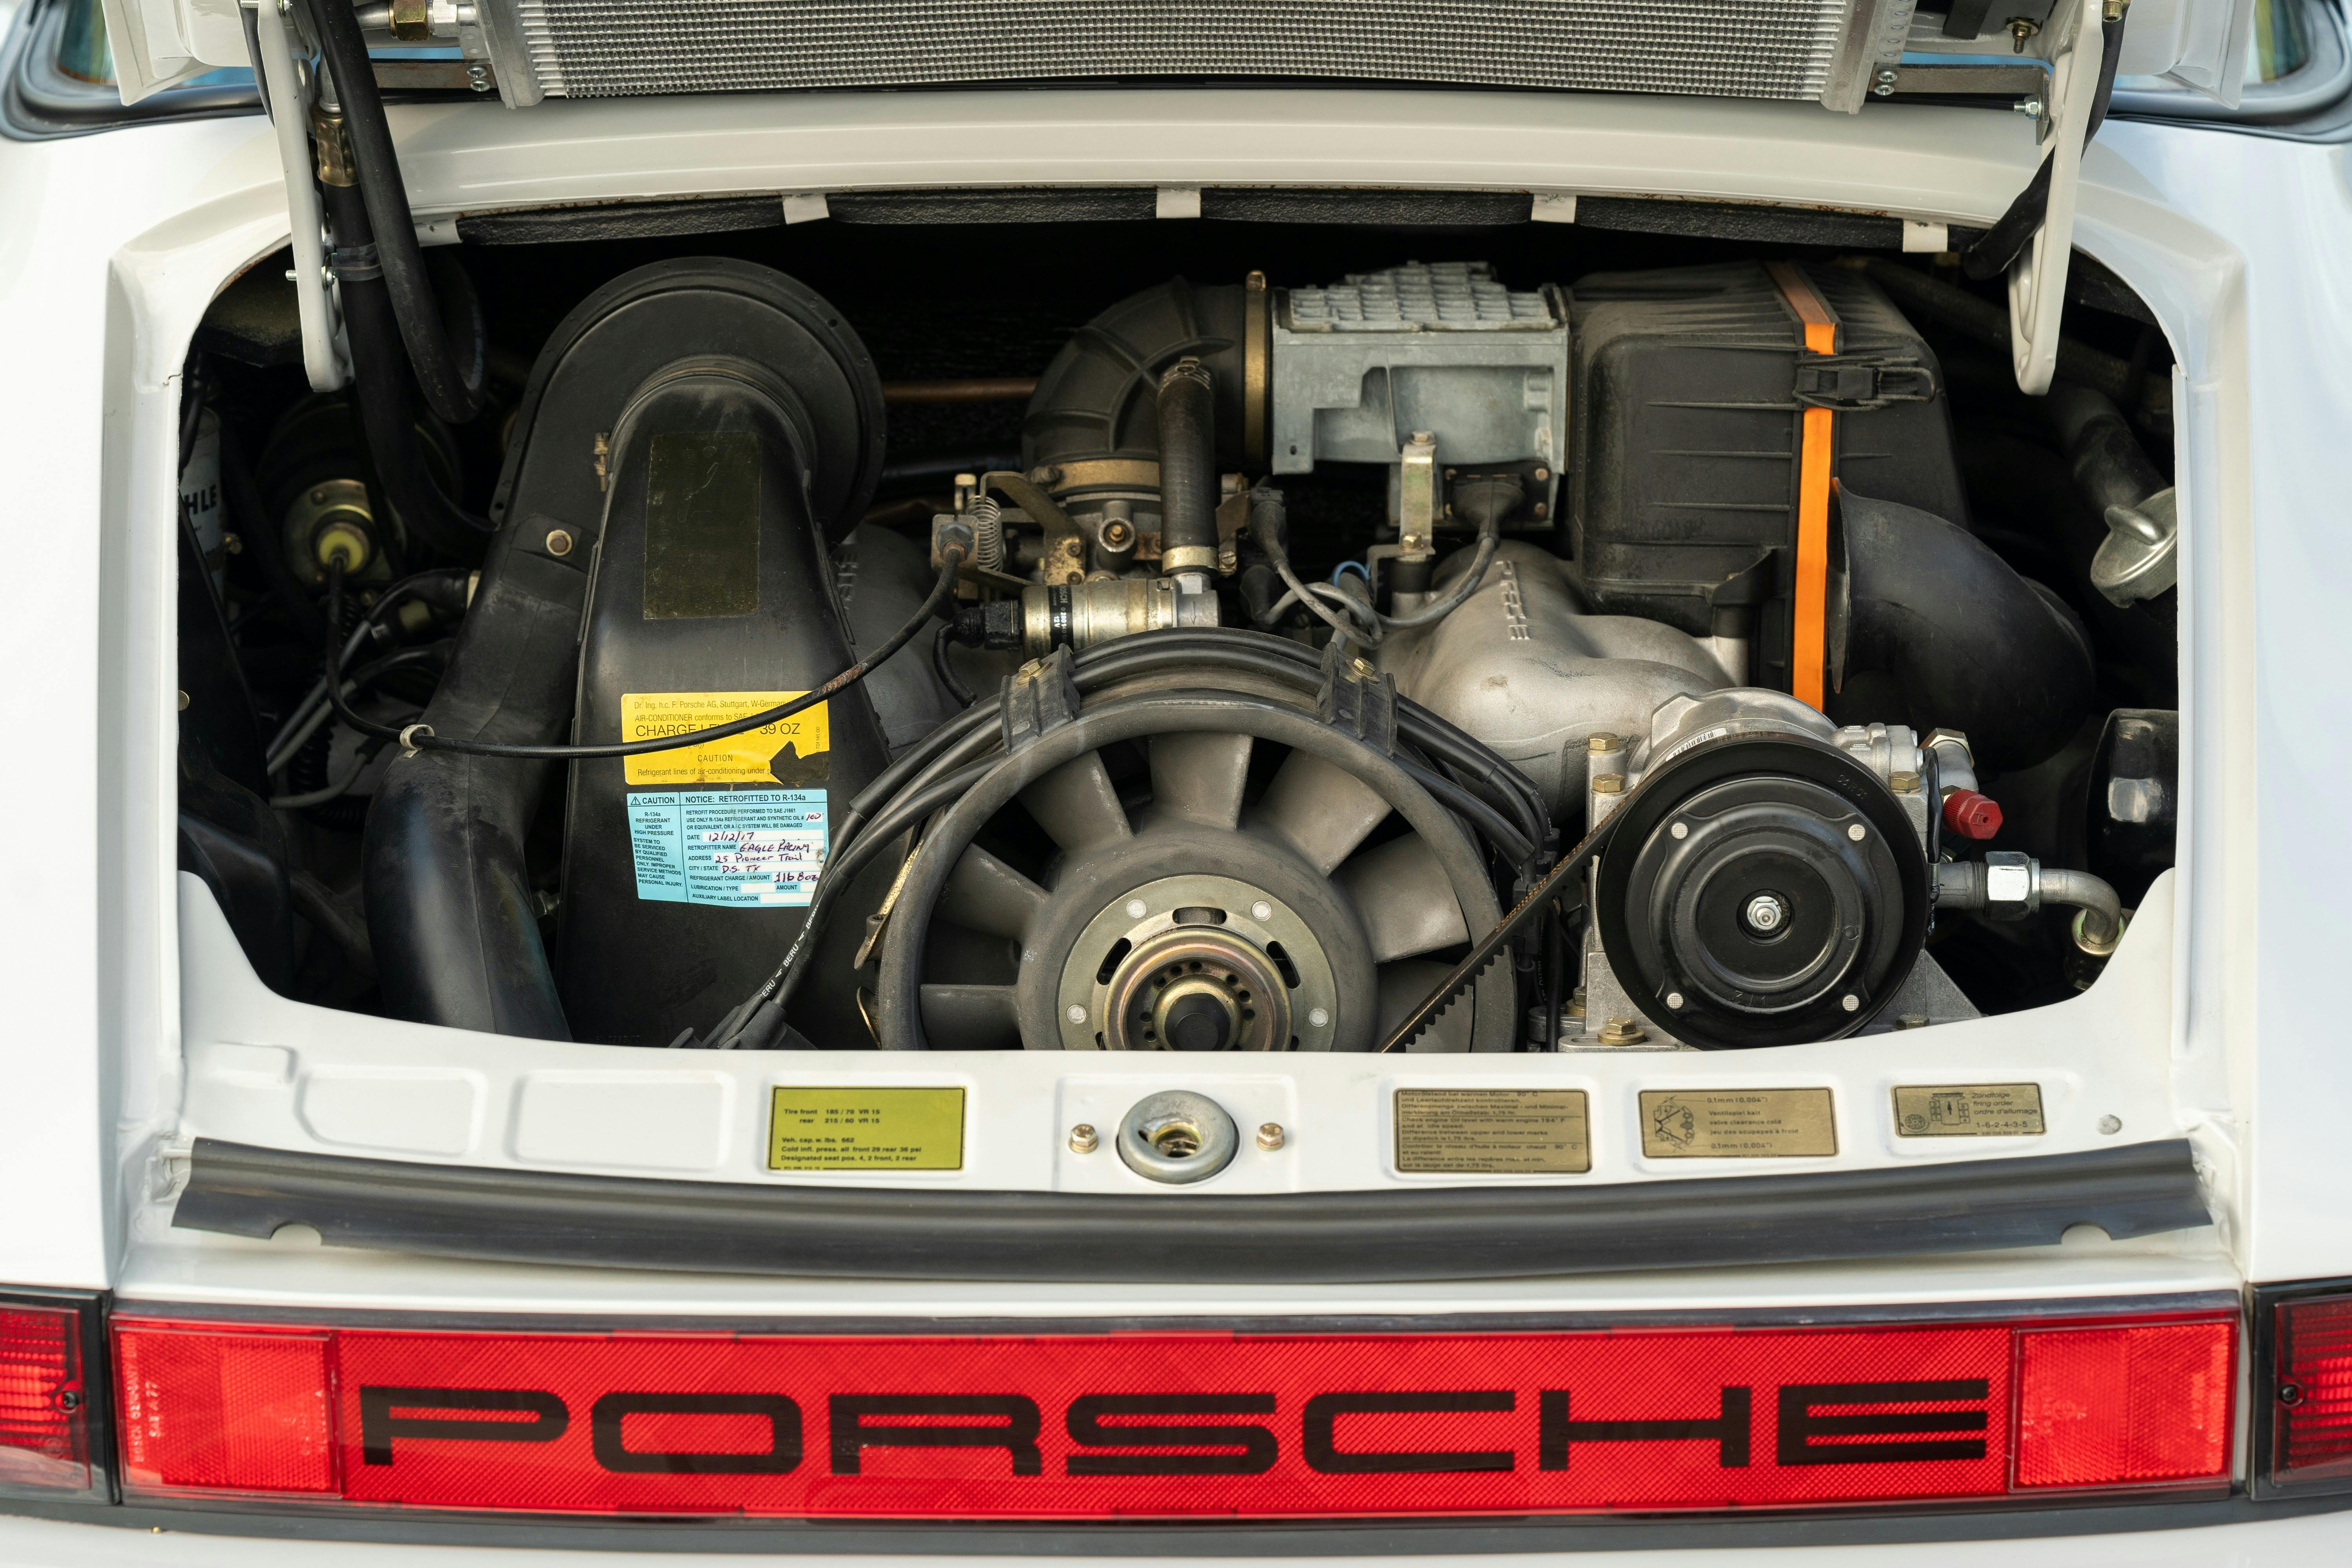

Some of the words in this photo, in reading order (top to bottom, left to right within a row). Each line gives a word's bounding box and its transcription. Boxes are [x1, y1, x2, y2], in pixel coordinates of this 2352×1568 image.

[646, 702, 657, 710] Ing.
[720, 701, 749, 709] Stuttgart,
[636, 724, 696, 737] CHARGE
[760, 724, 776, 734] 39
[780, 723, 800, 734] OZ
[709, 831, 754, 842] 12/12/17
[740, 842, 774, 853] EAGLE
[779, 852, 802, 861] Trail
[784, 944, 799, 967] BERU
[762, 980, 776, 997] ERU
[360, 1379, 1988, 1475] PORSCHE
